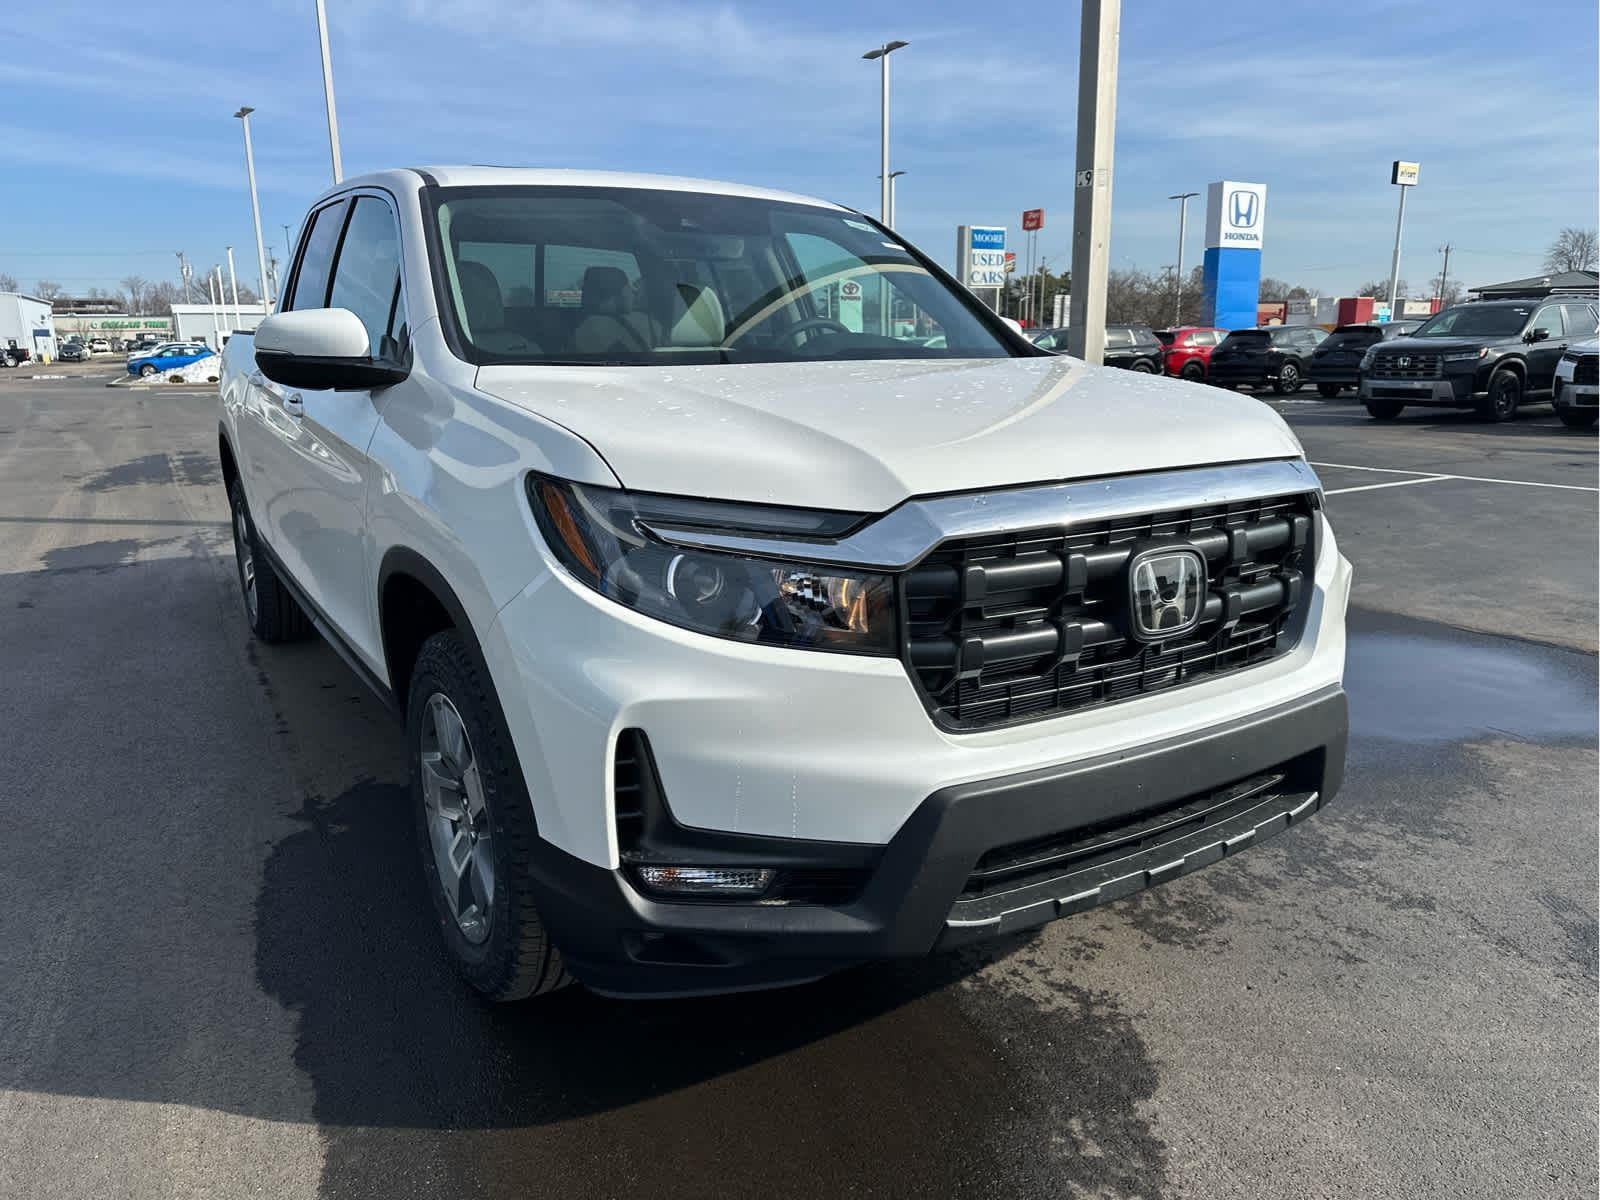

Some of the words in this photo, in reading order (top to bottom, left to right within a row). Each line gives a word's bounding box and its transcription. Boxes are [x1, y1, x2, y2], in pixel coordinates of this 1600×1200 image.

[973, 232, 1004, 243] MOORE
[1223, 232, 1260, 241] HONDA
[972, 254, 1004, 267] USED
[970, 271, 1005, 284] CARS
[101, 321, 141, 329] DOLLAR
